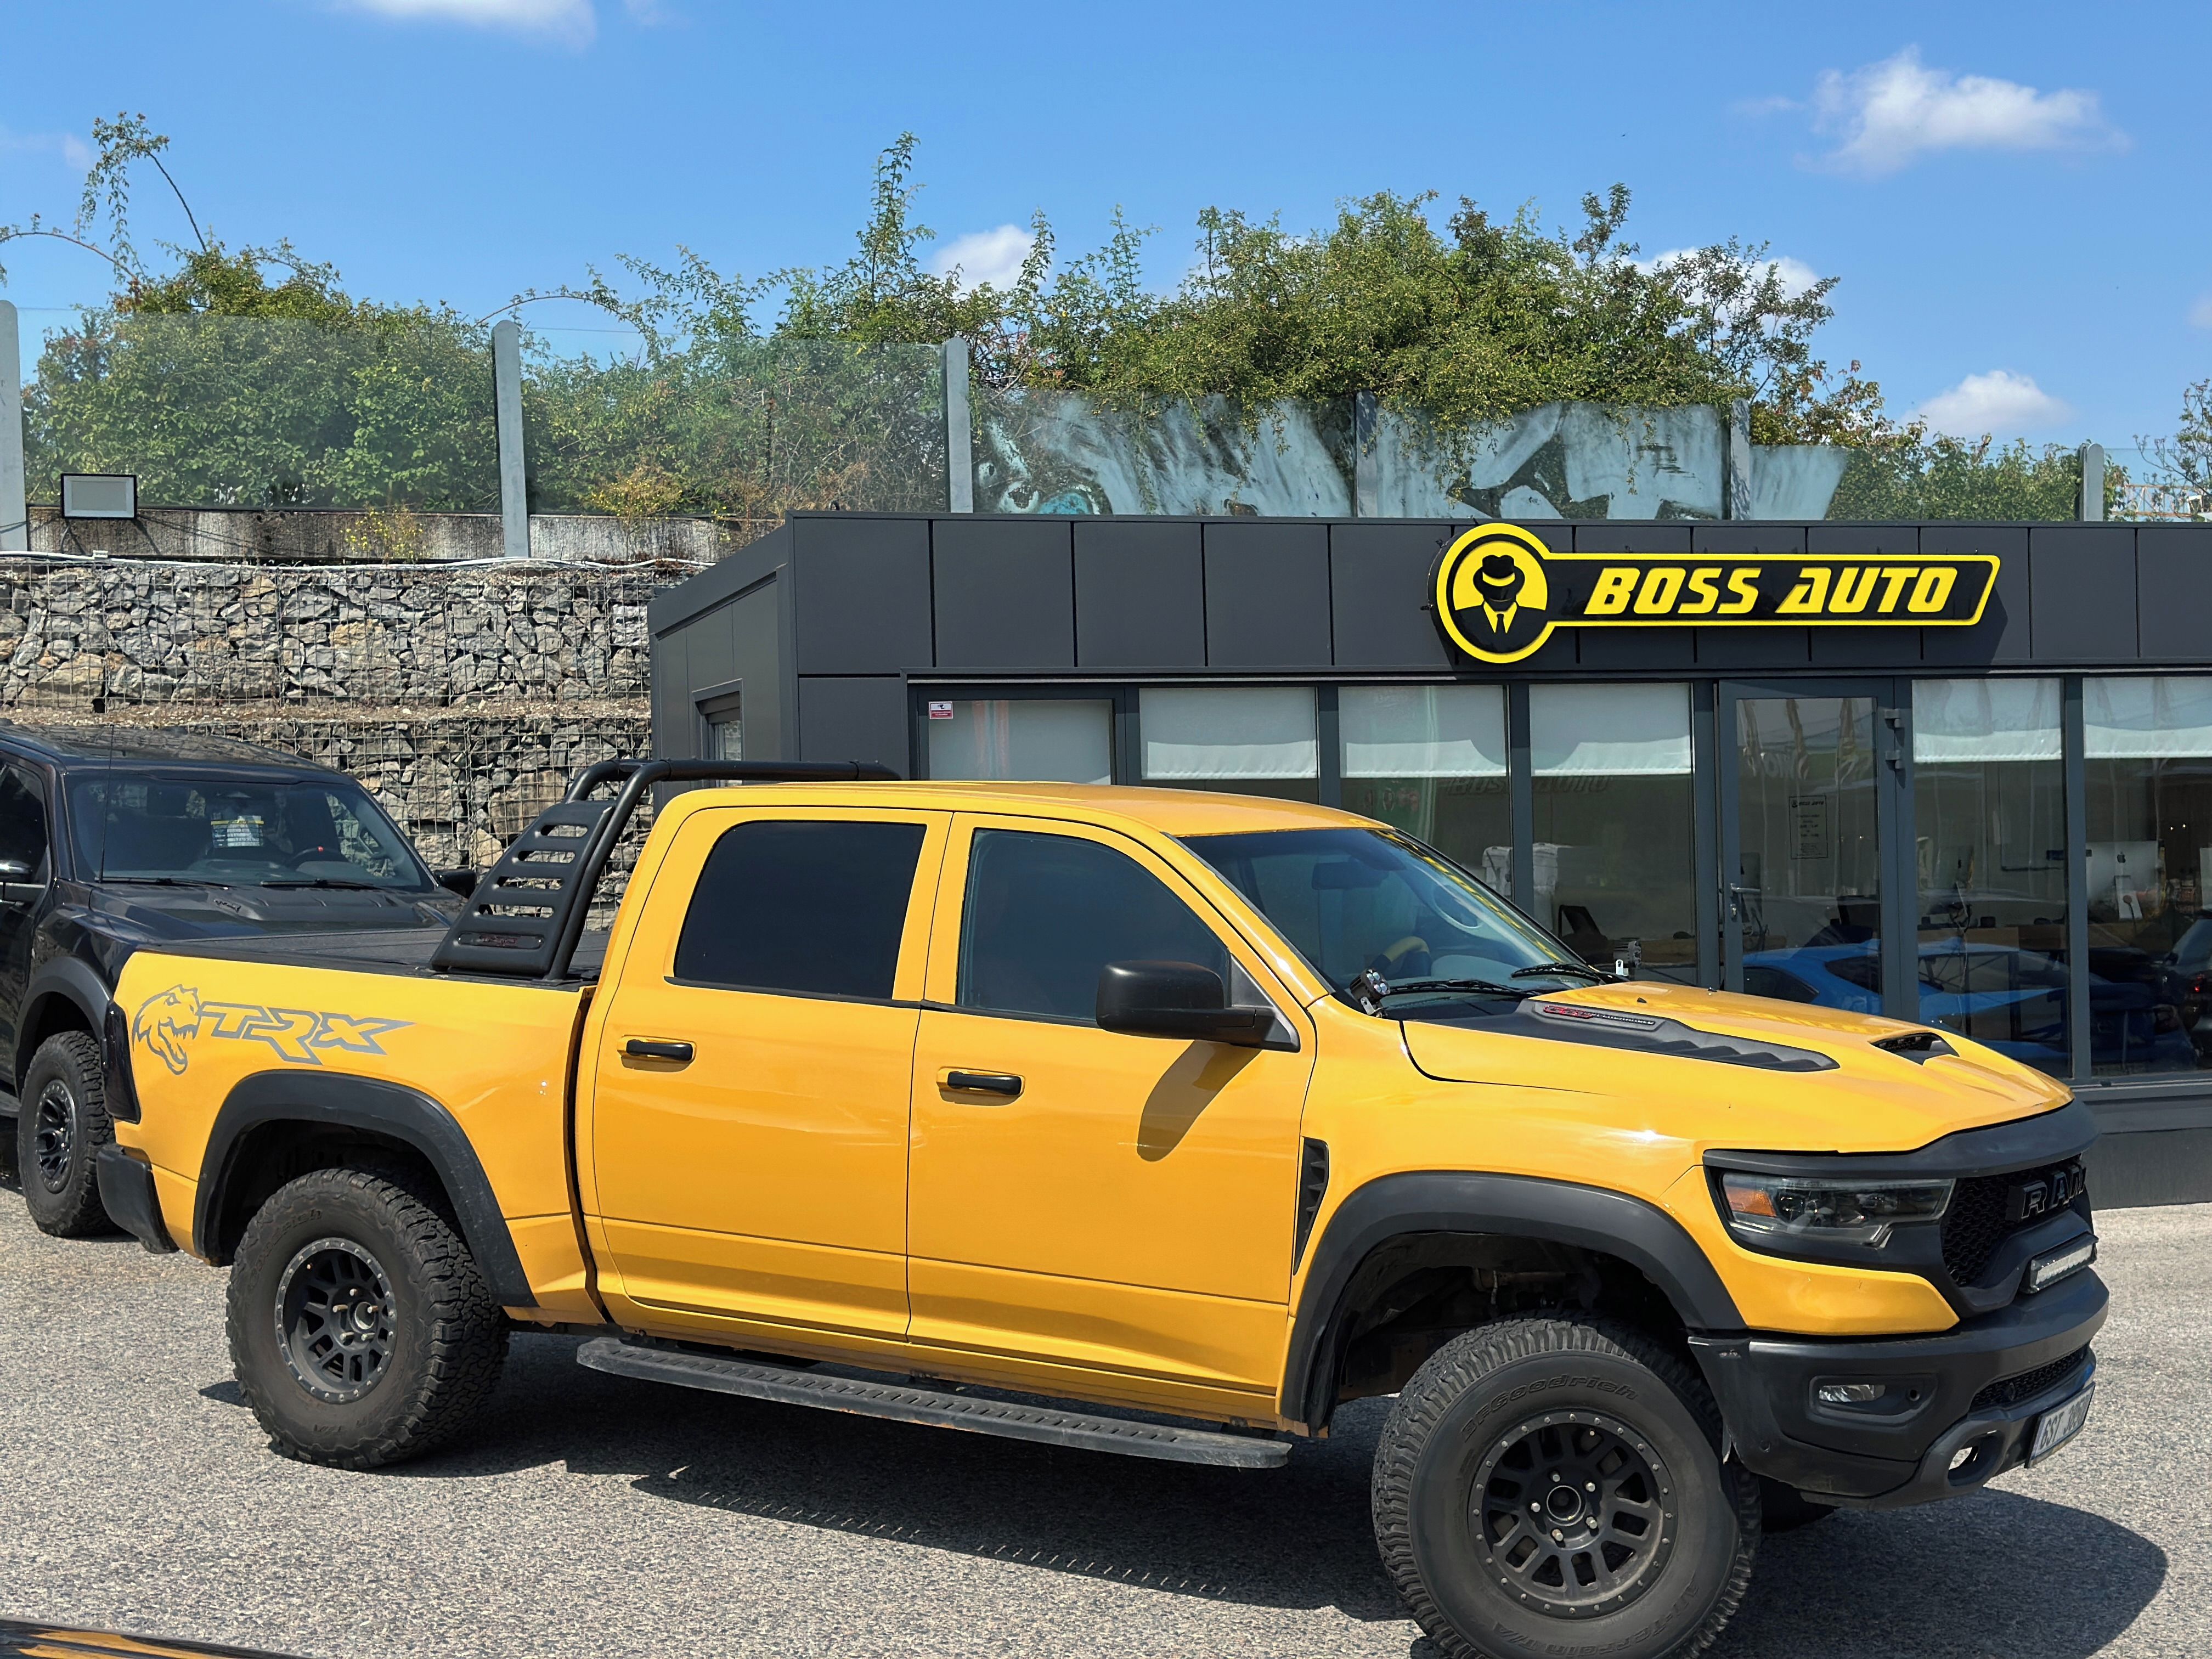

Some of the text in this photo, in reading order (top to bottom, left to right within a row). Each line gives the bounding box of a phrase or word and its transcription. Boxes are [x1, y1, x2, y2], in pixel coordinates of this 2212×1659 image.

[1584, 567, 1958, 614] BOSS AUTO
[201, 1001, 416, 1065] TRX
[1461, 1374, 1638, 1443] BFGoodrich
